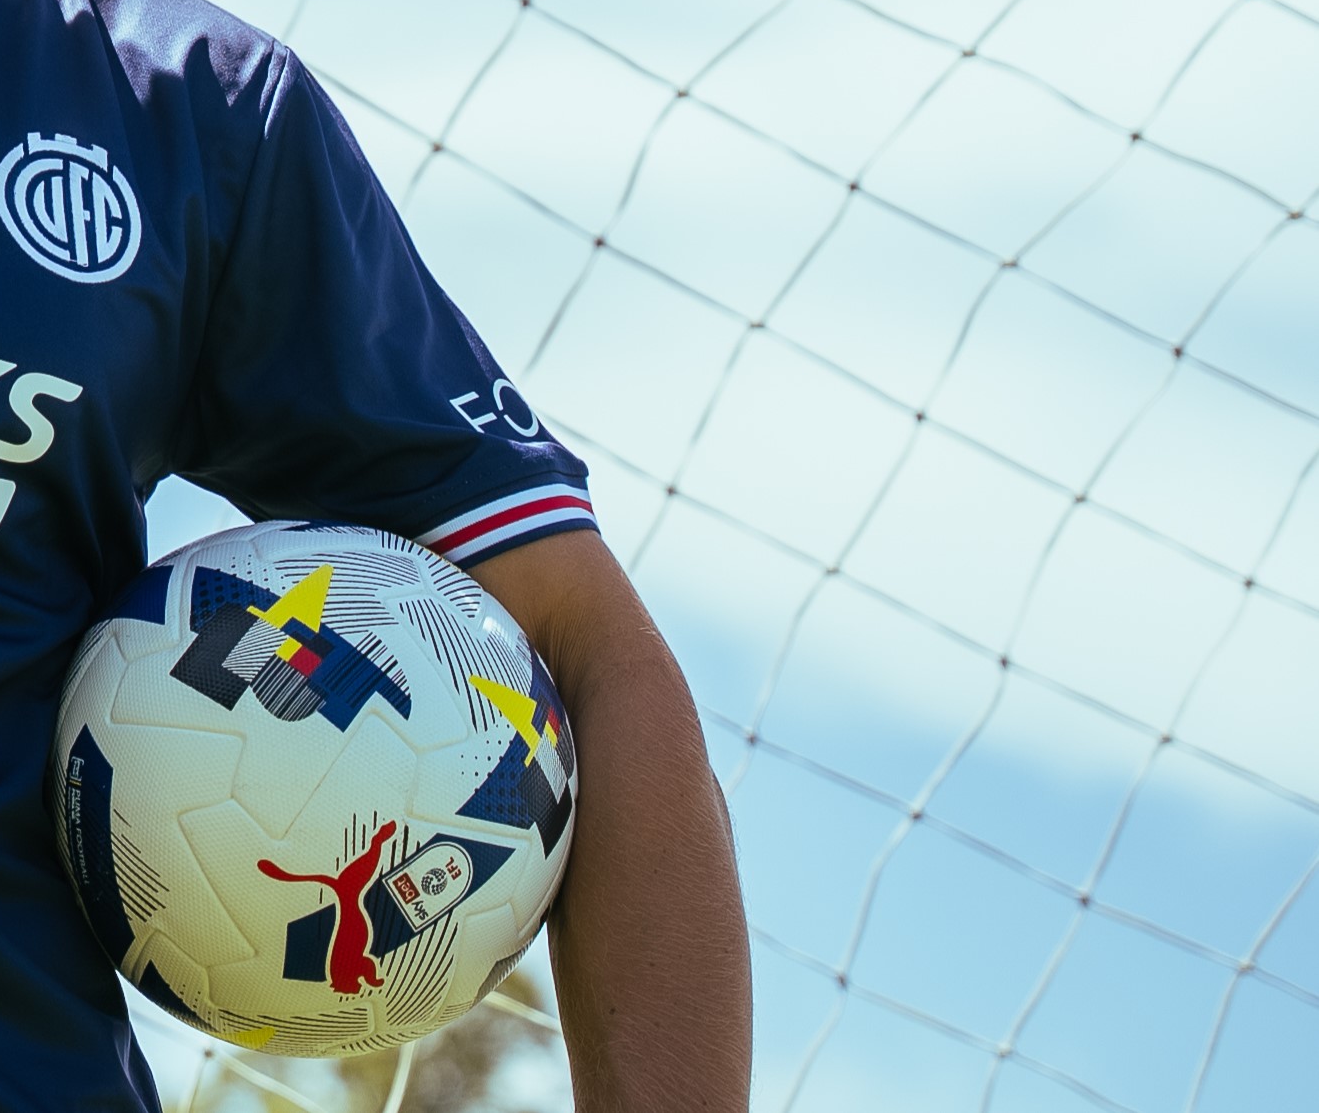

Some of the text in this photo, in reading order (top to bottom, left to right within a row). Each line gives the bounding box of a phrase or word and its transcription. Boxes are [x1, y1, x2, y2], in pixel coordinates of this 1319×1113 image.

[445, 856, 462, 881] EFL
[397, 876, 429, 921] sky bet
